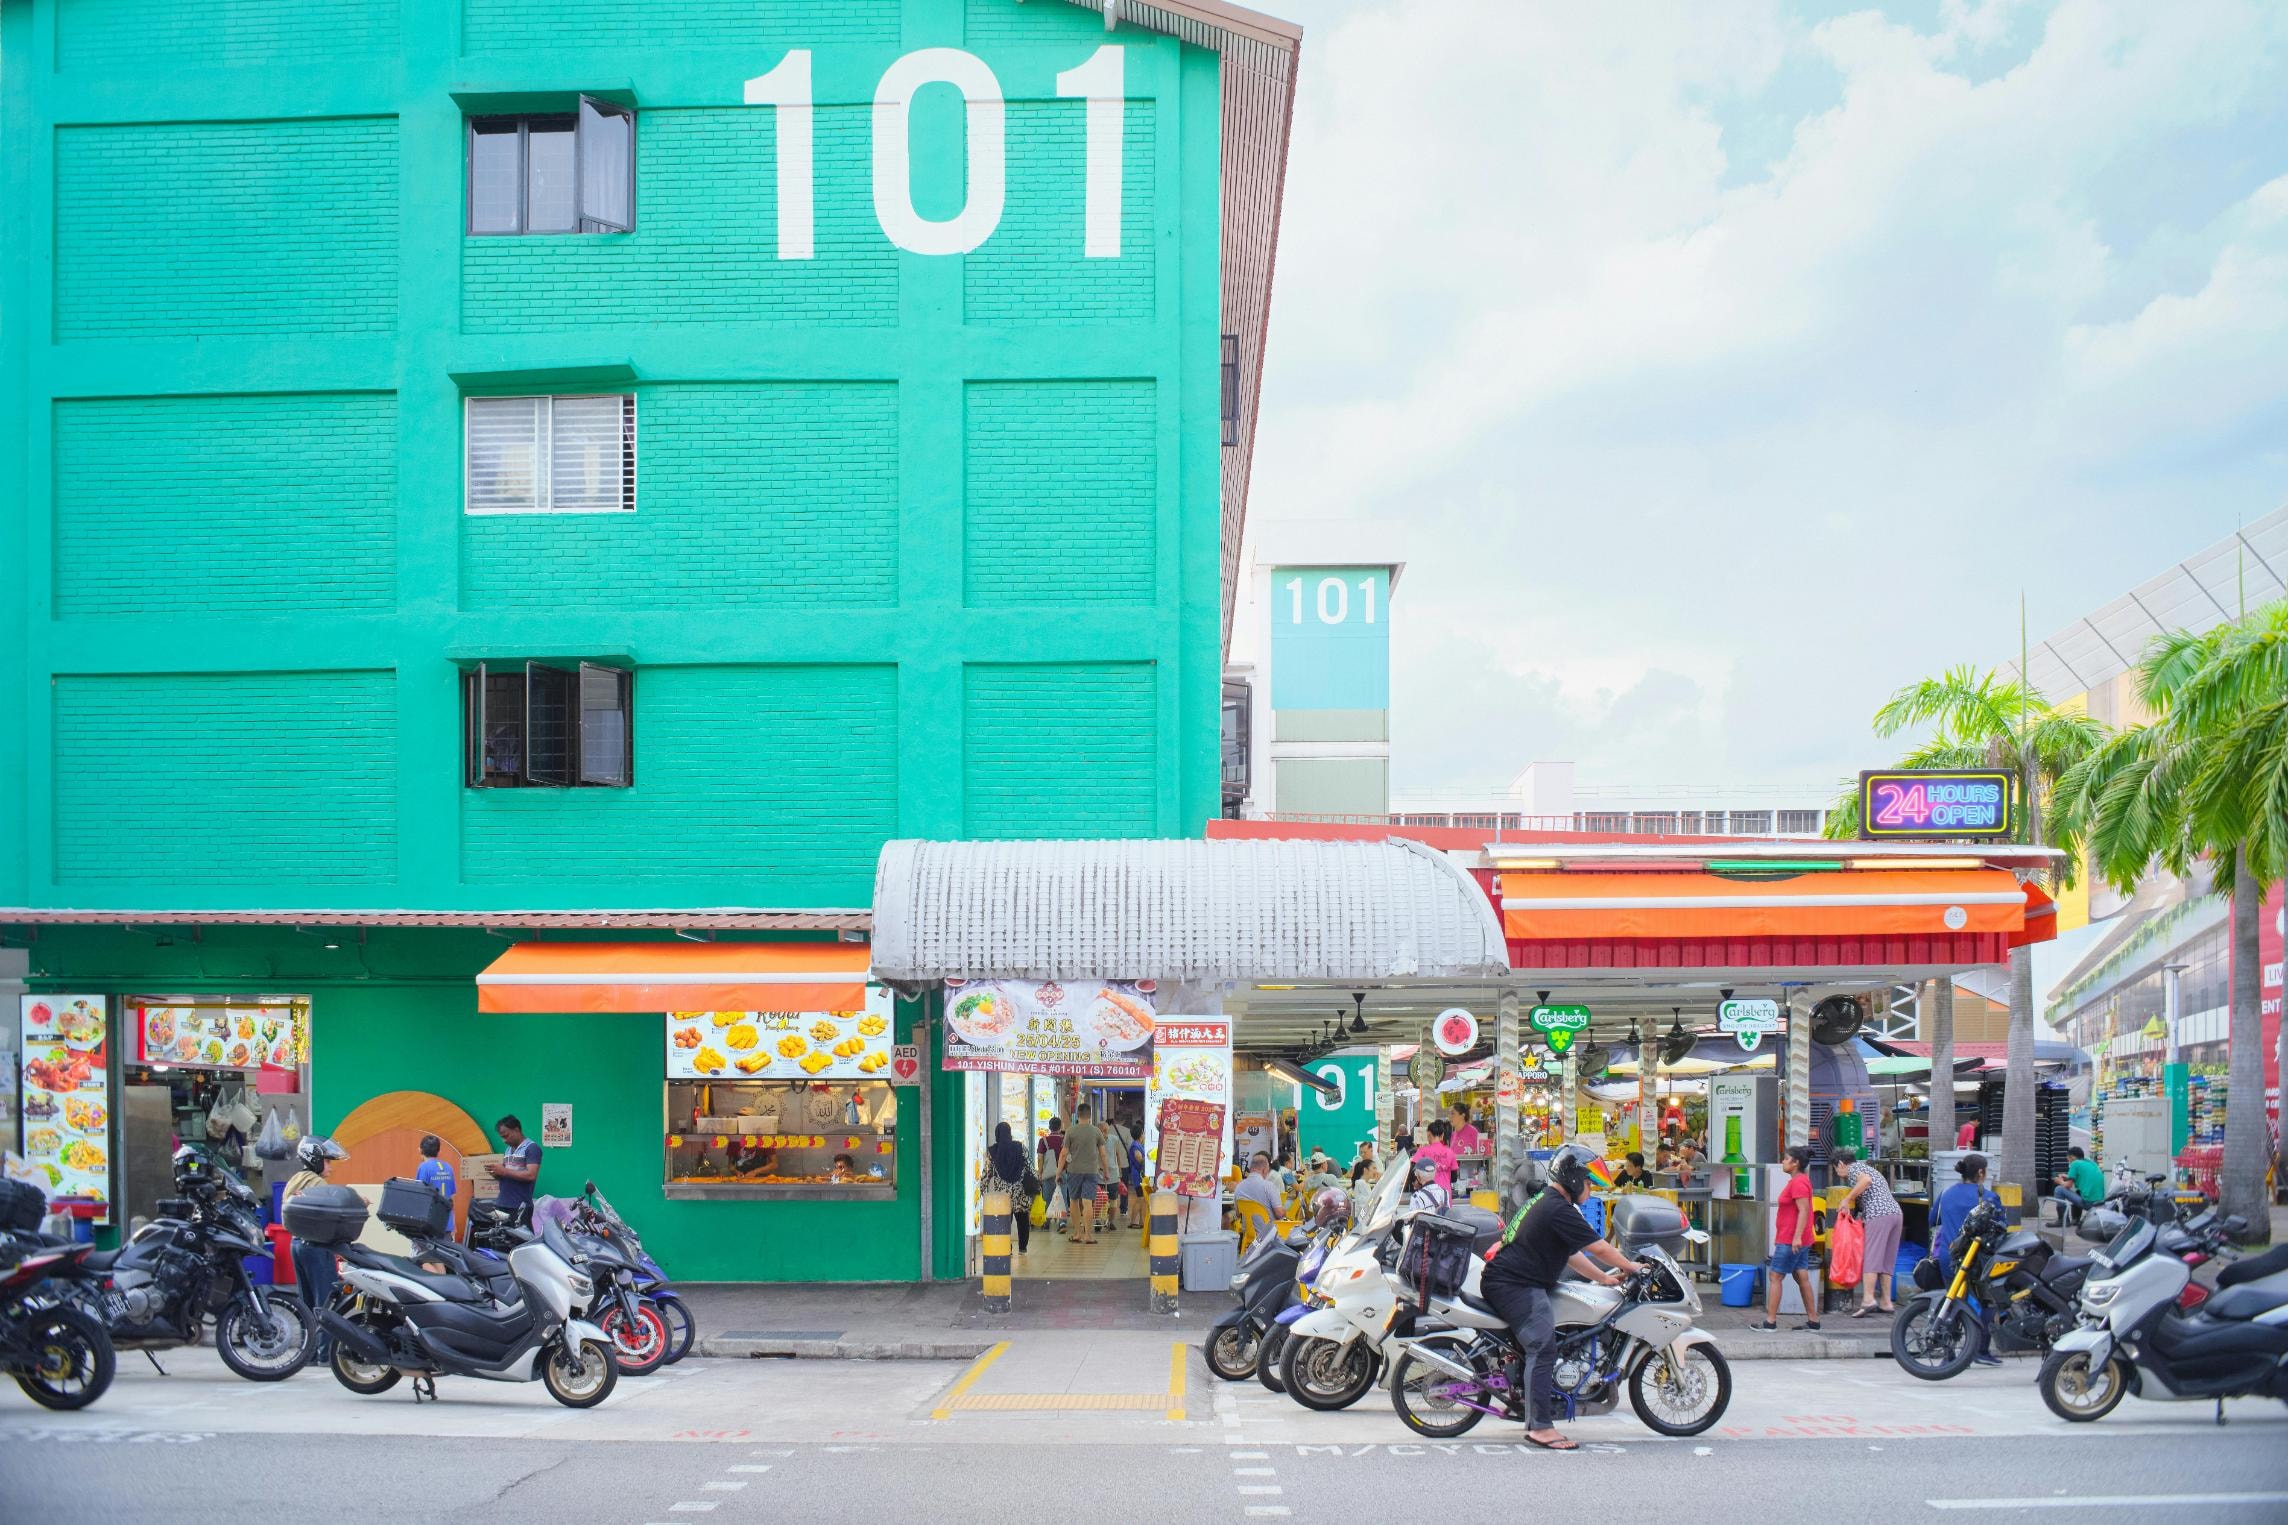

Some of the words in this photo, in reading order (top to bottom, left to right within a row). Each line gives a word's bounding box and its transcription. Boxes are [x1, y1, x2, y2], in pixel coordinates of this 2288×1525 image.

[743, 44, 1124, 260] 101
[1286, 577, 1375, 624] 101
[1877, 784, 1929, 824] 24
[1927, 784, 2000, 803] HOURS
[1931, 805, 1995, 825] OPEN
[1534, 1008, 1587, 1028] Carlsberg
[1723, 1003, 1775, 1020] Carlsberg
[1016, 1033, 1081, 1048] 25/04/25
[895, 1047, 917, 1057] AED
[1010, 1050, 1036, 1059] NEW
[1039, 1051, 1090, 1061] OPENING
[957, 1061, 973, 1069] 101
[977, 1061, 1017, 1070] YISHUN
[1018, 1063, 1037, 1072] AVE
[1049, 1065, 1086, 1073] #01-101
[1090, 1066, 1104, 1075] (S)
[1107, 1066, 1141, 1075] 760101
[1716, 1083, 1752, 1098] Carlsberg
[1295, 1443, 1628, 1457] M/CYCLS
